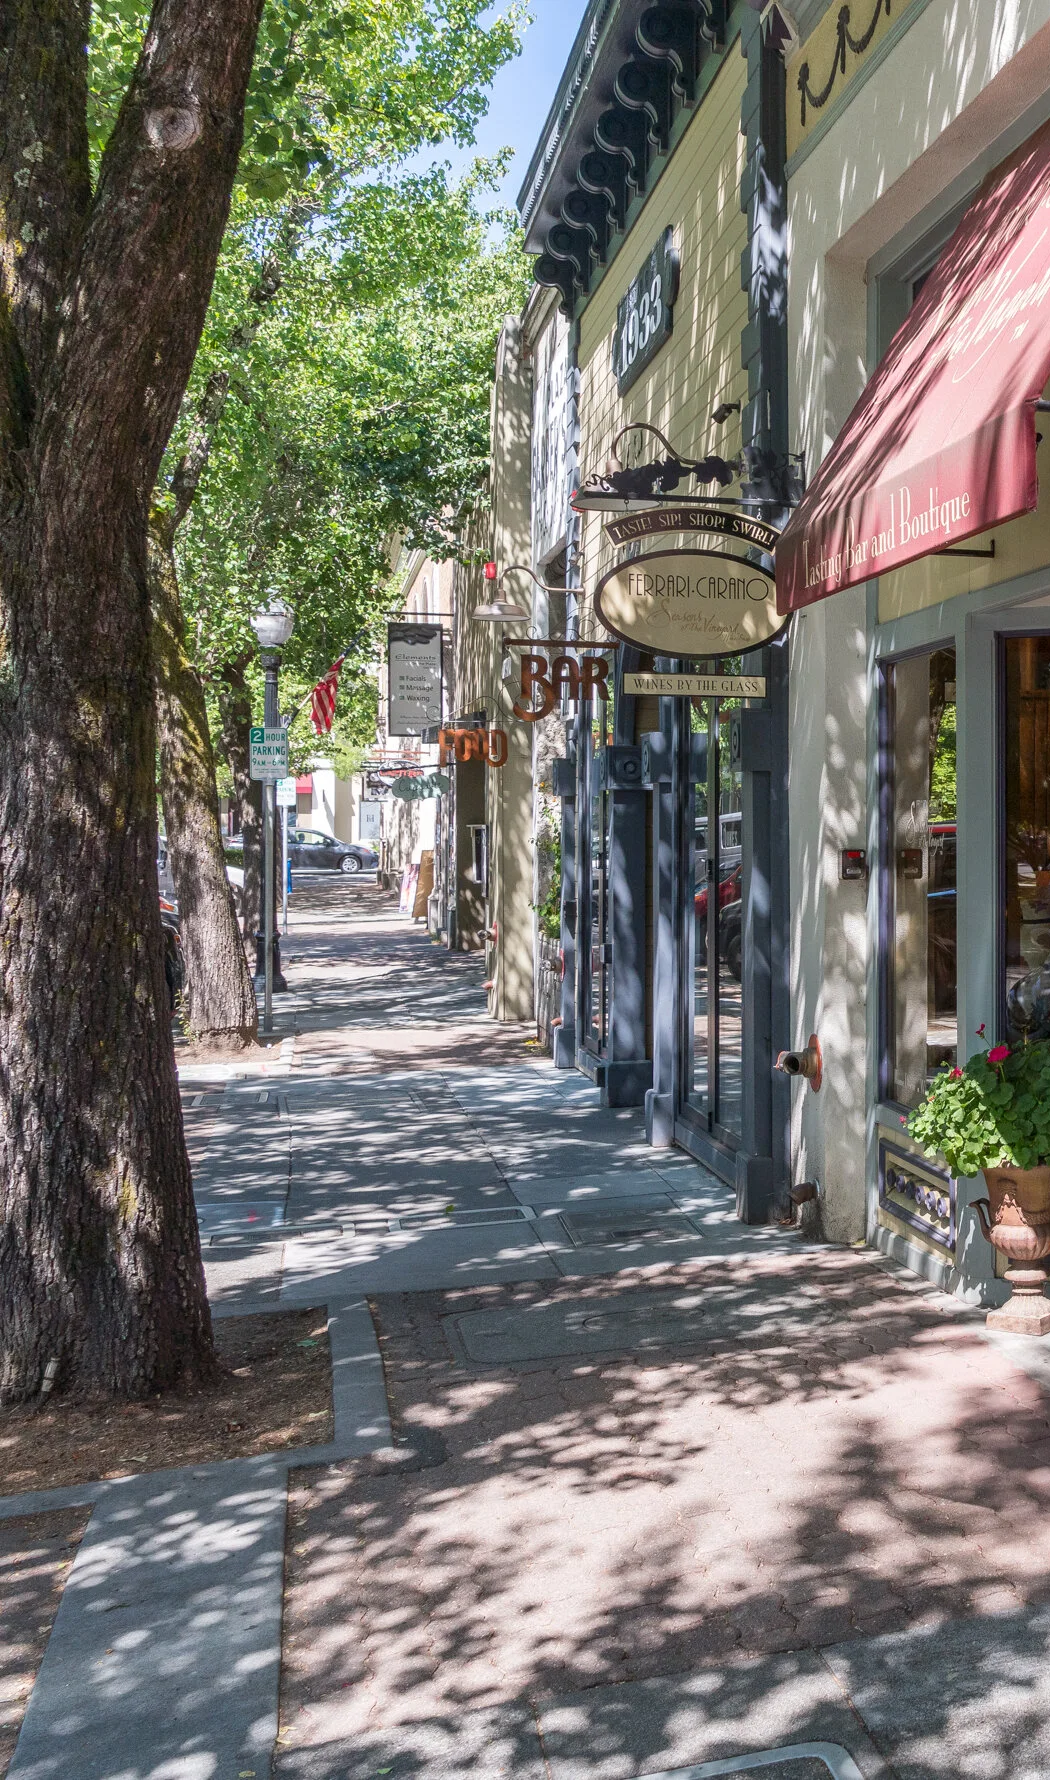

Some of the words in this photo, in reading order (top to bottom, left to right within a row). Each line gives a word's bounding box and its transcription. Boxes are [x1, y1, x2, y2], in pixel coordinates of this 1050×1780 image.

[620, 274, 662, 377] 1933
[613, 517, 653, 540] TASTE!
[659, 513, 682, 527] SIP!
[690, 513, 726, 529] SHOP!
[732, 520, 774, 546] SWIRL!
[803, 539, 842, 588] Tasting
[845, 516, 869, 570] Bar
[871, 493, 895, 558] and
[900, 486, 970, 545] Boutique
[406, 695, 430, 703] Waxing
[513, 654, 612, 722] BAR
[633, 678, 673, 690] WINES
[677, 680, 692, 690] BY
[696, 681, 718, 691] THE
[721, 681, 758, 692] GLASS
[252, 746, 286, 756] PARKING
[253, 730, 262, 742] 2
[265, 733, 286, 742] HOUR
[438, 728, 508, 767] FOOD
